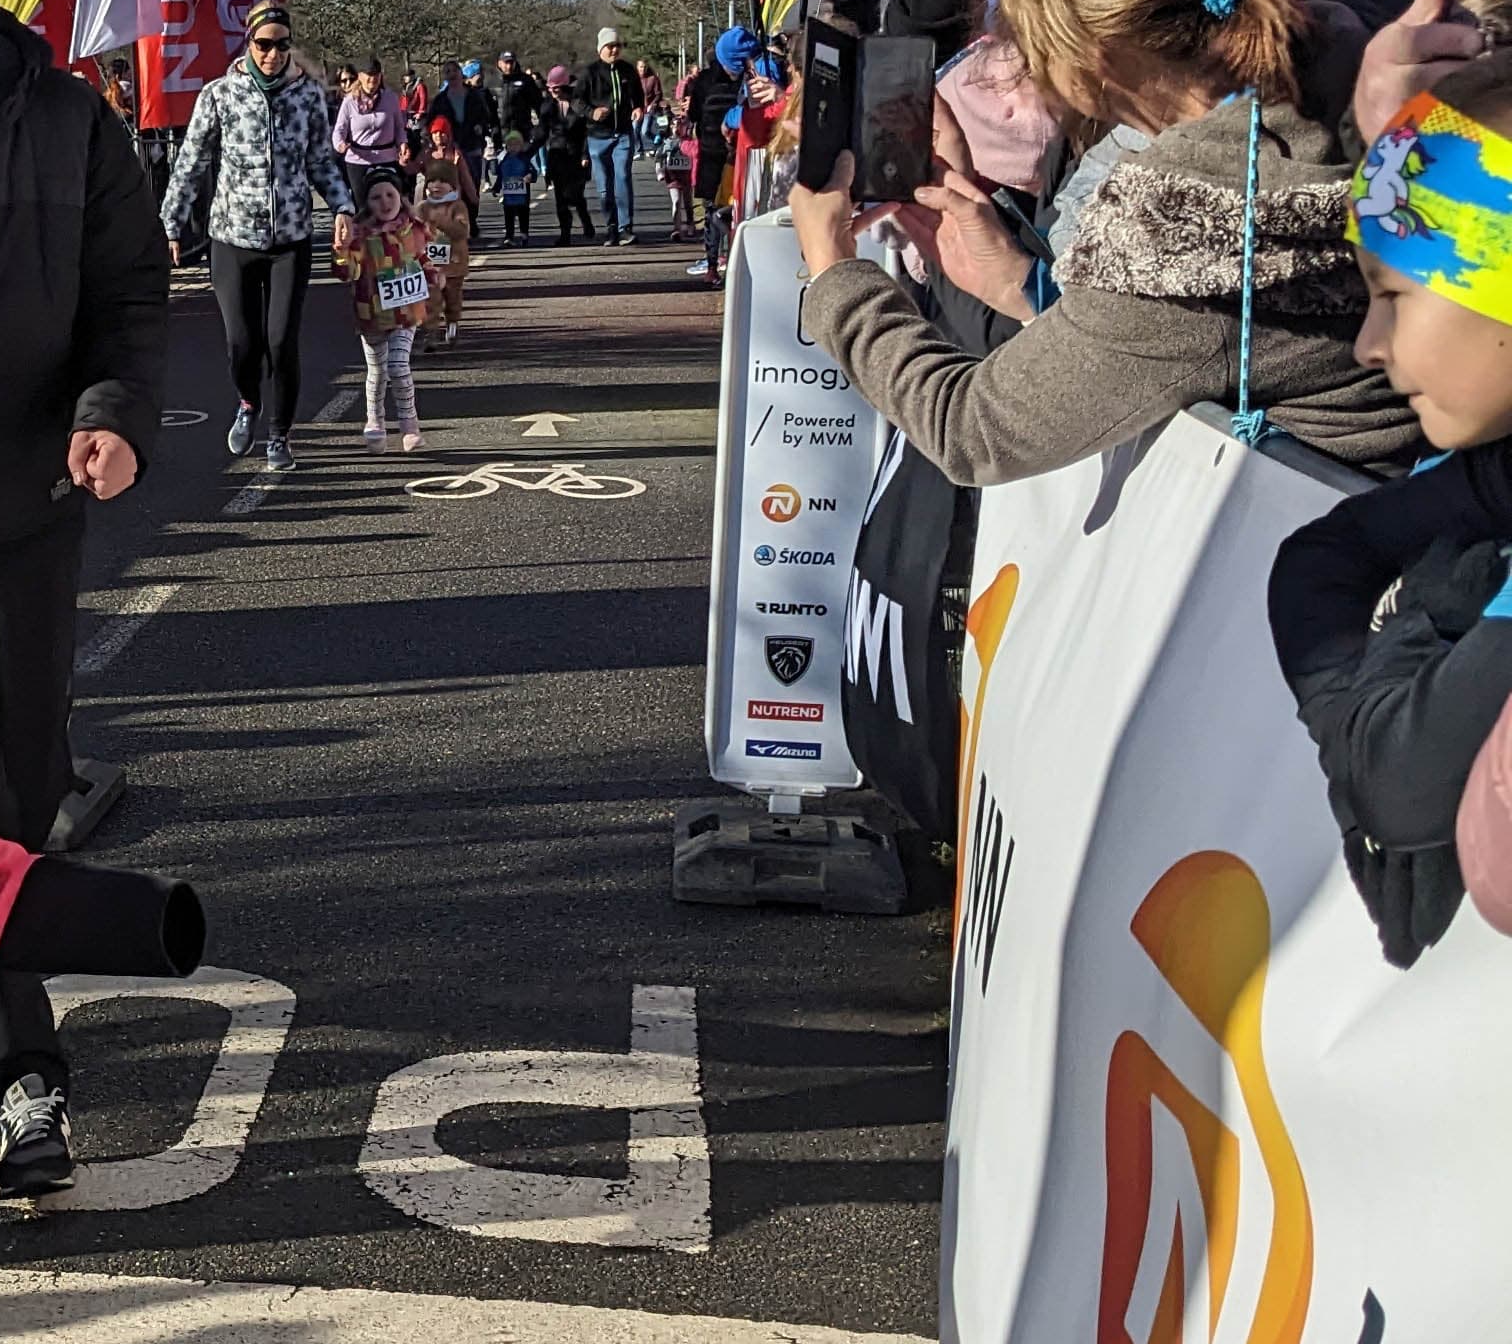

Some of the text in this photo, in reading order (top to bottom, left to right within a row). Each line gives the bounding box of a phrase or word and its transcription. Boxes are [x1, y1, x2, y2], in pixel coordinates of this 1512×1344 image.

[428, 245, 447, 259] 94
[382, 274, 423, 301] 3107
[754, 360, 851, 390] innogy
[784, 413, 855, 428] Powered
[782, 431, 853, 448] by MVM
[808, 497, 836, 512] NN
[778, 547, 836, 566] ŠKODA
[769, 603, 828, 617] RUNTO
[752, 704, 820, 718] NUTREND
[966, 771, 1016, 999] NN
